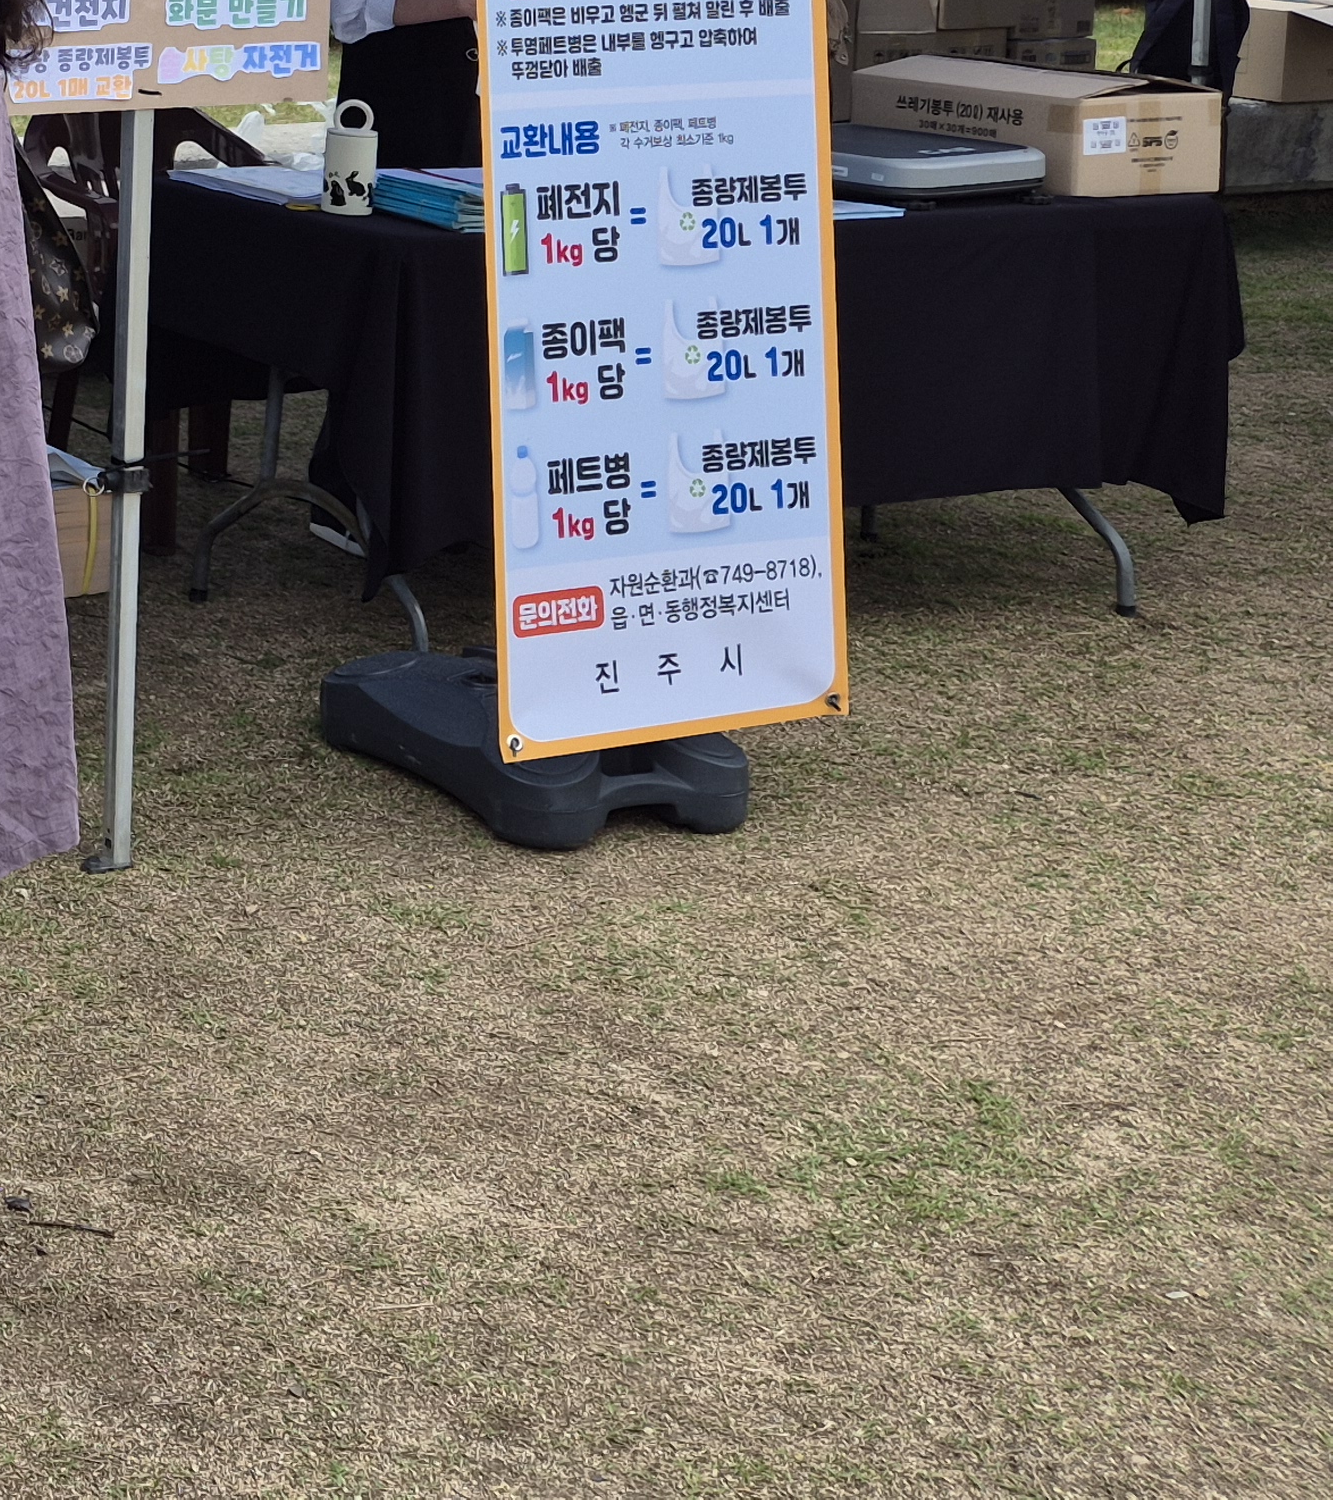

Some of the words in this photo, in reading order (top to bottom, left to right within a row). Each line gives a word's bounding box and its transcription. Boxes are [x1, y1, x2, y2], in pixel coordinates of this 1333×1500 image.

[509, 8, 566, 30] 종이팩은
[571, 6, 616, 25] 비우고
[654, 2, 669, 22] 뒤
[705, 0, 735, 19] 말린
[57, 45, 151, 73] 종량제봉투
[243, 44, 318, 75] 자전거
[510, 35, 598, 57] 투명페트병은
[601, 32, 647, 52] 내부를
[698, 27, 758, 49] 압축하여
[13, 79, 51, 100] 20L
[57, 77, 90, 98] 1매
[96, 74, 132, 99] 교환
[511, 60, 568, 81] 뚜껑닫아
[572, 58, 603, 78] 배출
[895, 95, 955, 117] 쓰레기봉투
[986, 106, 1025, 127] 재사용
[499, 120, 601, 160] 교환내용
[535, 181, 621, 222] 폐전지
[690, 172, 809, 208] 종량제봉투
[540, 233, 584, 267] 1kg
[591, 226, 621, 264] 당
[701, 216, 753, 249] 20L
[759, 214, 801, 247] 1개
[541, 317, 626, 361] 종이팩
[696, 304, 813, 340] 종량제봉투
[706, 348, 758, 382] 20L
[764, 347, 806, 378] 1개
[546, 370, 590, 405] 1kg
[597, 363, 627, 400] 당
[701, 436, 818, 474] 종량제봉투
[546, 452, 632, 496] 페트병
[711, 481, 764, 516] 20L
[769, 478, 811, 511] 1개
[551, 507, 595, 541] 1kg
[603, 497, 632, 536] 당
[517, 596, 599, 631] 문의전화
